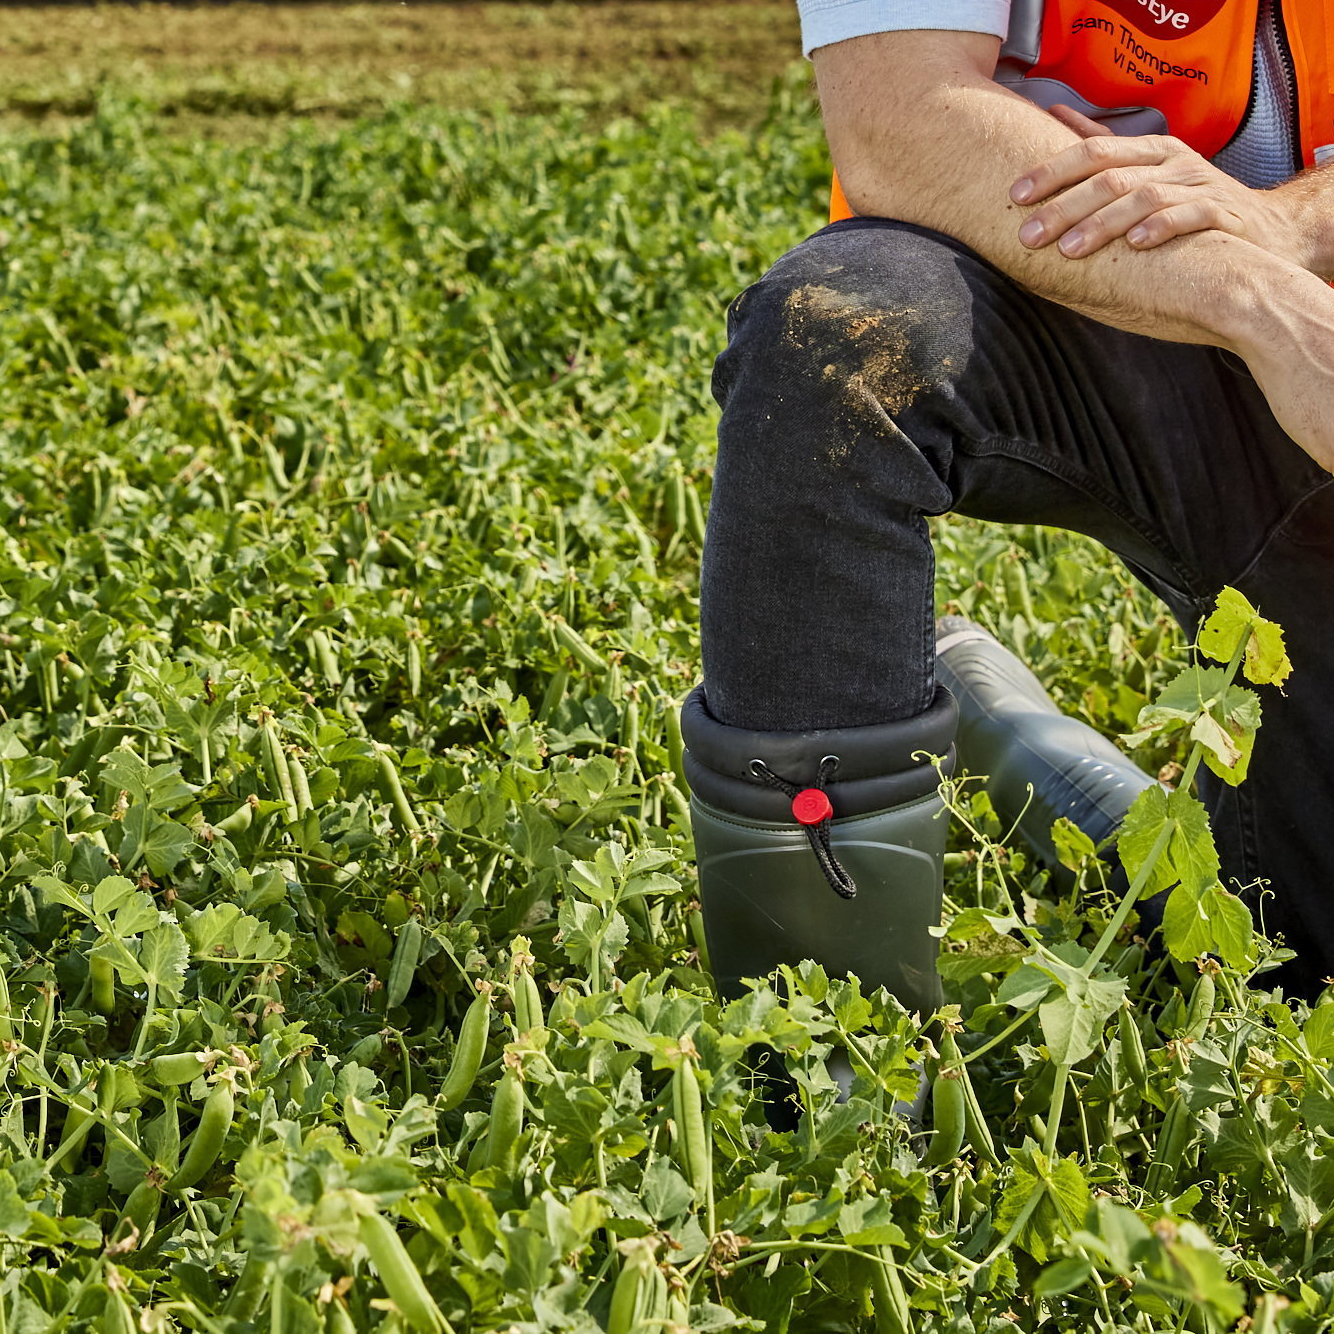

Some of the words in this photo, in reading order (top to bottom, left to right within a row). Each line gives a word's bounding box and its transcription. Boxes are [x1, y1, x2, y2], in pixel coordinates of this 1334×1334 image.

[1071, 17, 1114, 34] Sam
[1119, 24, 1209, 86] Thompson
[1126, 60, 1155, 86] Pea
